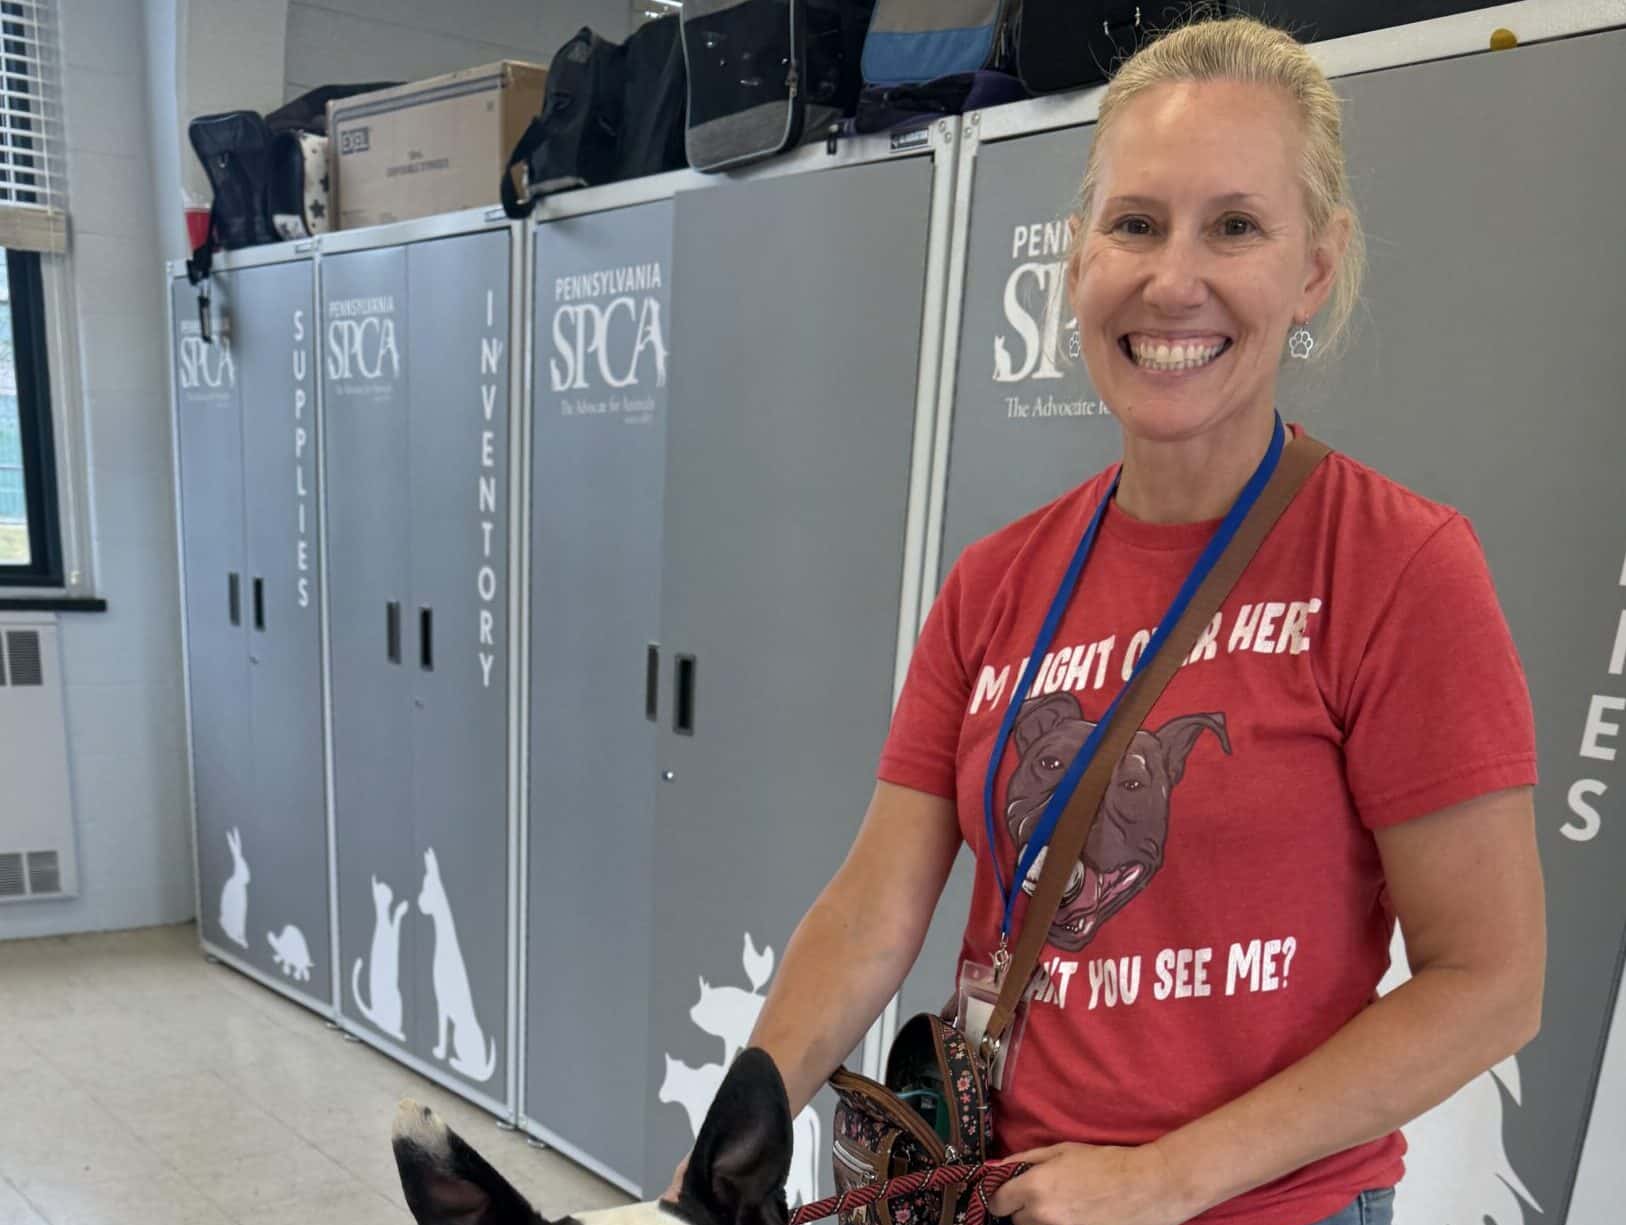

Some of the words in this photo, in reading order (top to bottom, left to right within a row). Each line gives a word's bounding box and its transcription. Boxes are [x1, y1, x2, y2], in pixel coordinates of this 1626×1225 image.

[554, 261, 661, 301] PENNSYLVANIA
[328, 316, 400, 379] SPCA
[550, 296, 668, 392] SPCA
[1004, 395, 1030, 418] The
[1031, 394, 1096, 417] Advocate
[292, 309, 309, 608] SUPPLIES
[478, 288, 498, 688] INVENTORY
[1120, 612, 1223, 683] OR
[1559, 550, 1626, 842] IES
[1026, 956, 1079, 1009] AN'T
[1088, 955, 1142, 1011] YOU
[1153, 947, 1213, 1001] SEE
[1225, 936, 1297, 996] ME?
